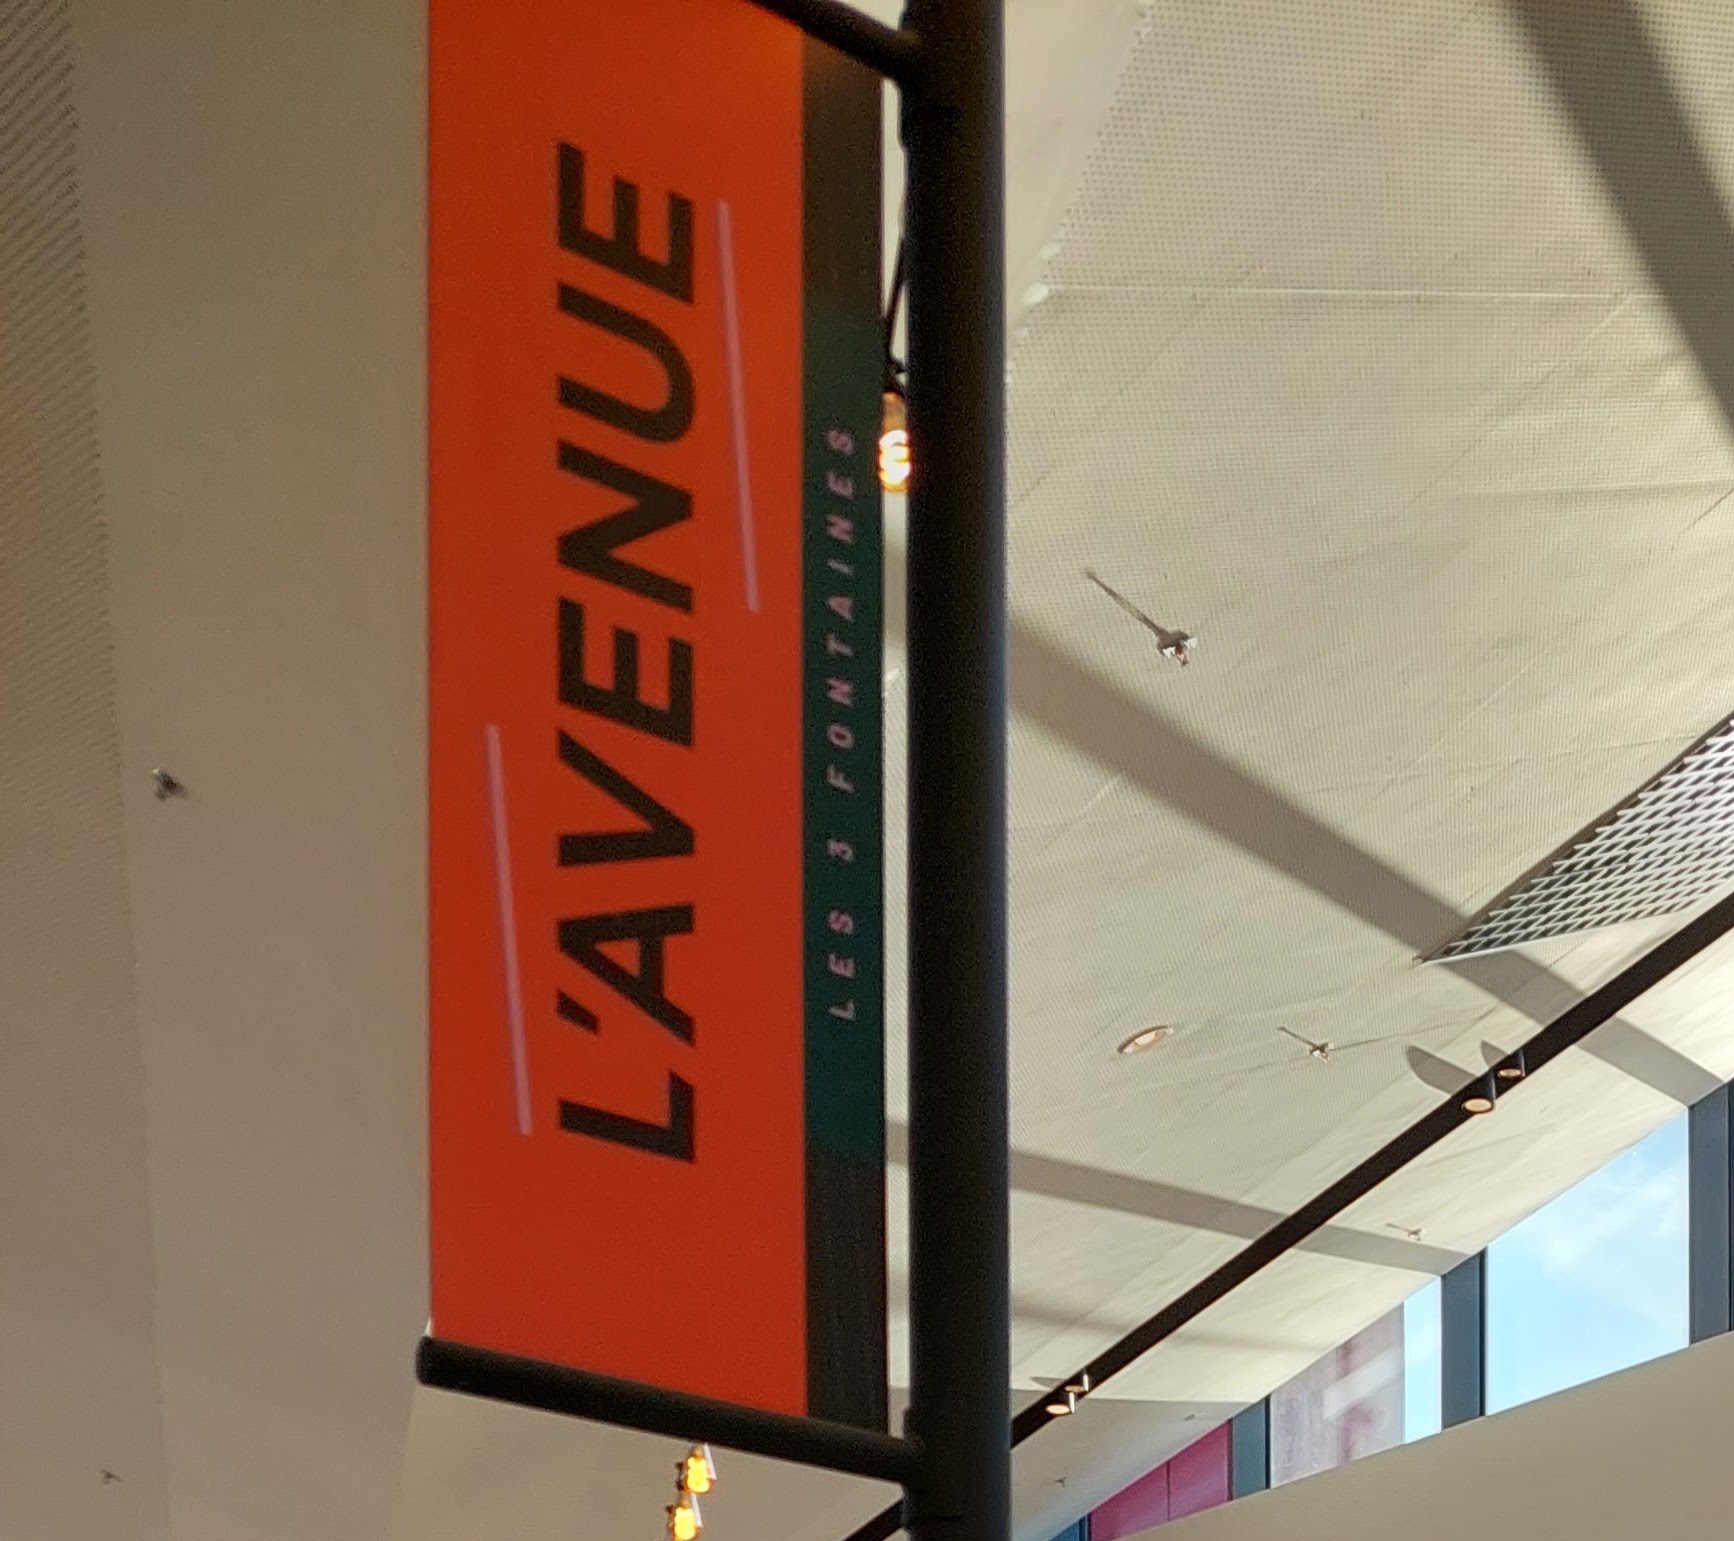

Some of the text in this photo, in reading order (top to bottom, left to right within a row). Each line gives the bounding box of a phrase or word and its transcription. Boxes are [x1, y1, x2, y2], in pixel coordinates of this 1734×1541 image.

[555, 140, 697, 1165] L'AVENUE
[827, 425, 855, 1021] LES 3 FONTAINES
